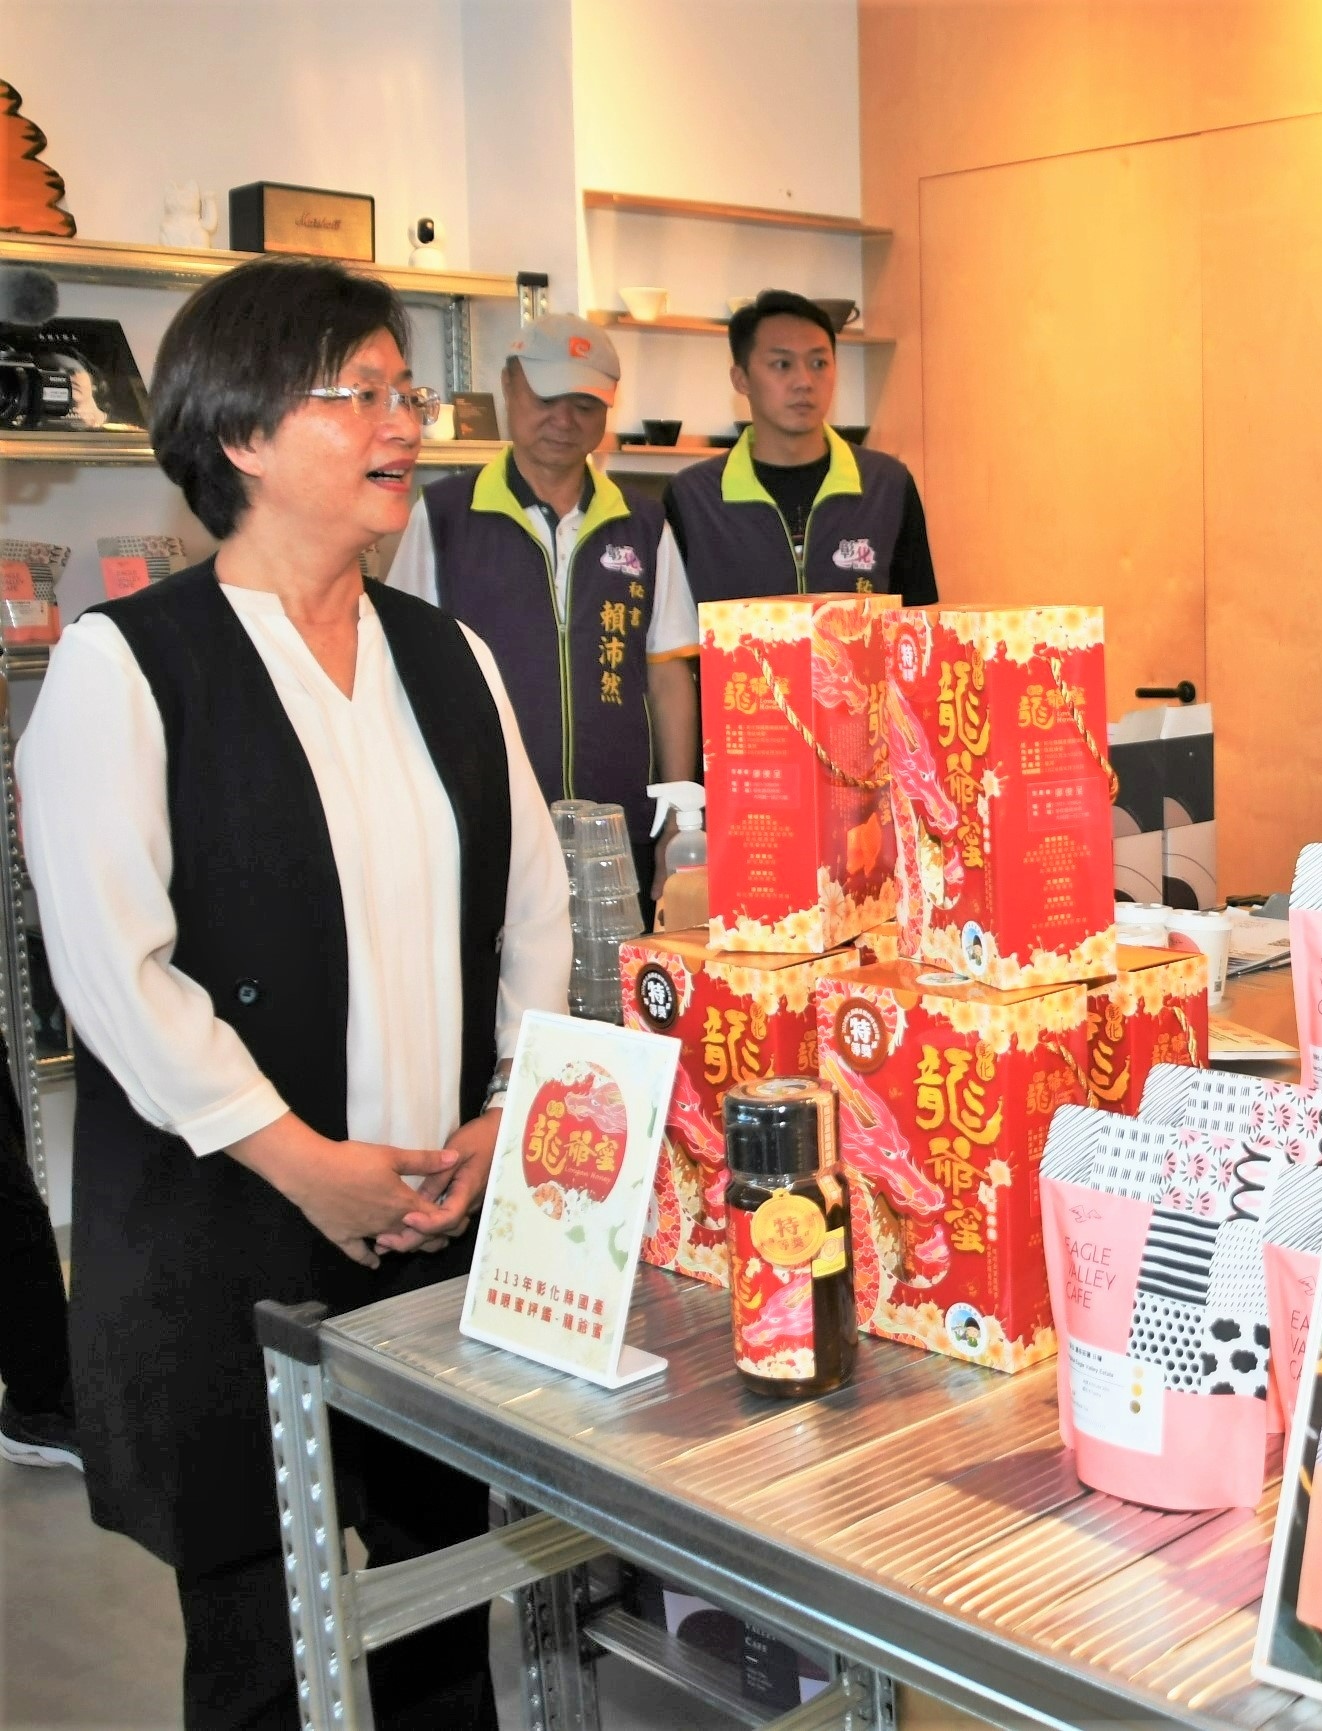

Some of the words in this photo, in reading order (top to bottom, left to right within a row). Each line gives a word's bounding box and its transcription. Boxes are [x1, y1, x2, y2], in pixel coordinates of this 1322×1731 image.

[599, 600, 627, 705] 賴沛然
[647, 980, 666, 1004] 特
[849, 1017, 872, 1043] 特
[1106, 1003, 1125, 1040] 彰化
[773, 1216, 800, 1238] 特
[1064, 1236, 1112, 1266] EAGLE
[494, 1268, 605, 1316] 113年彰化縣國產
[1065, 1281, 1093, 1310] CAFE
